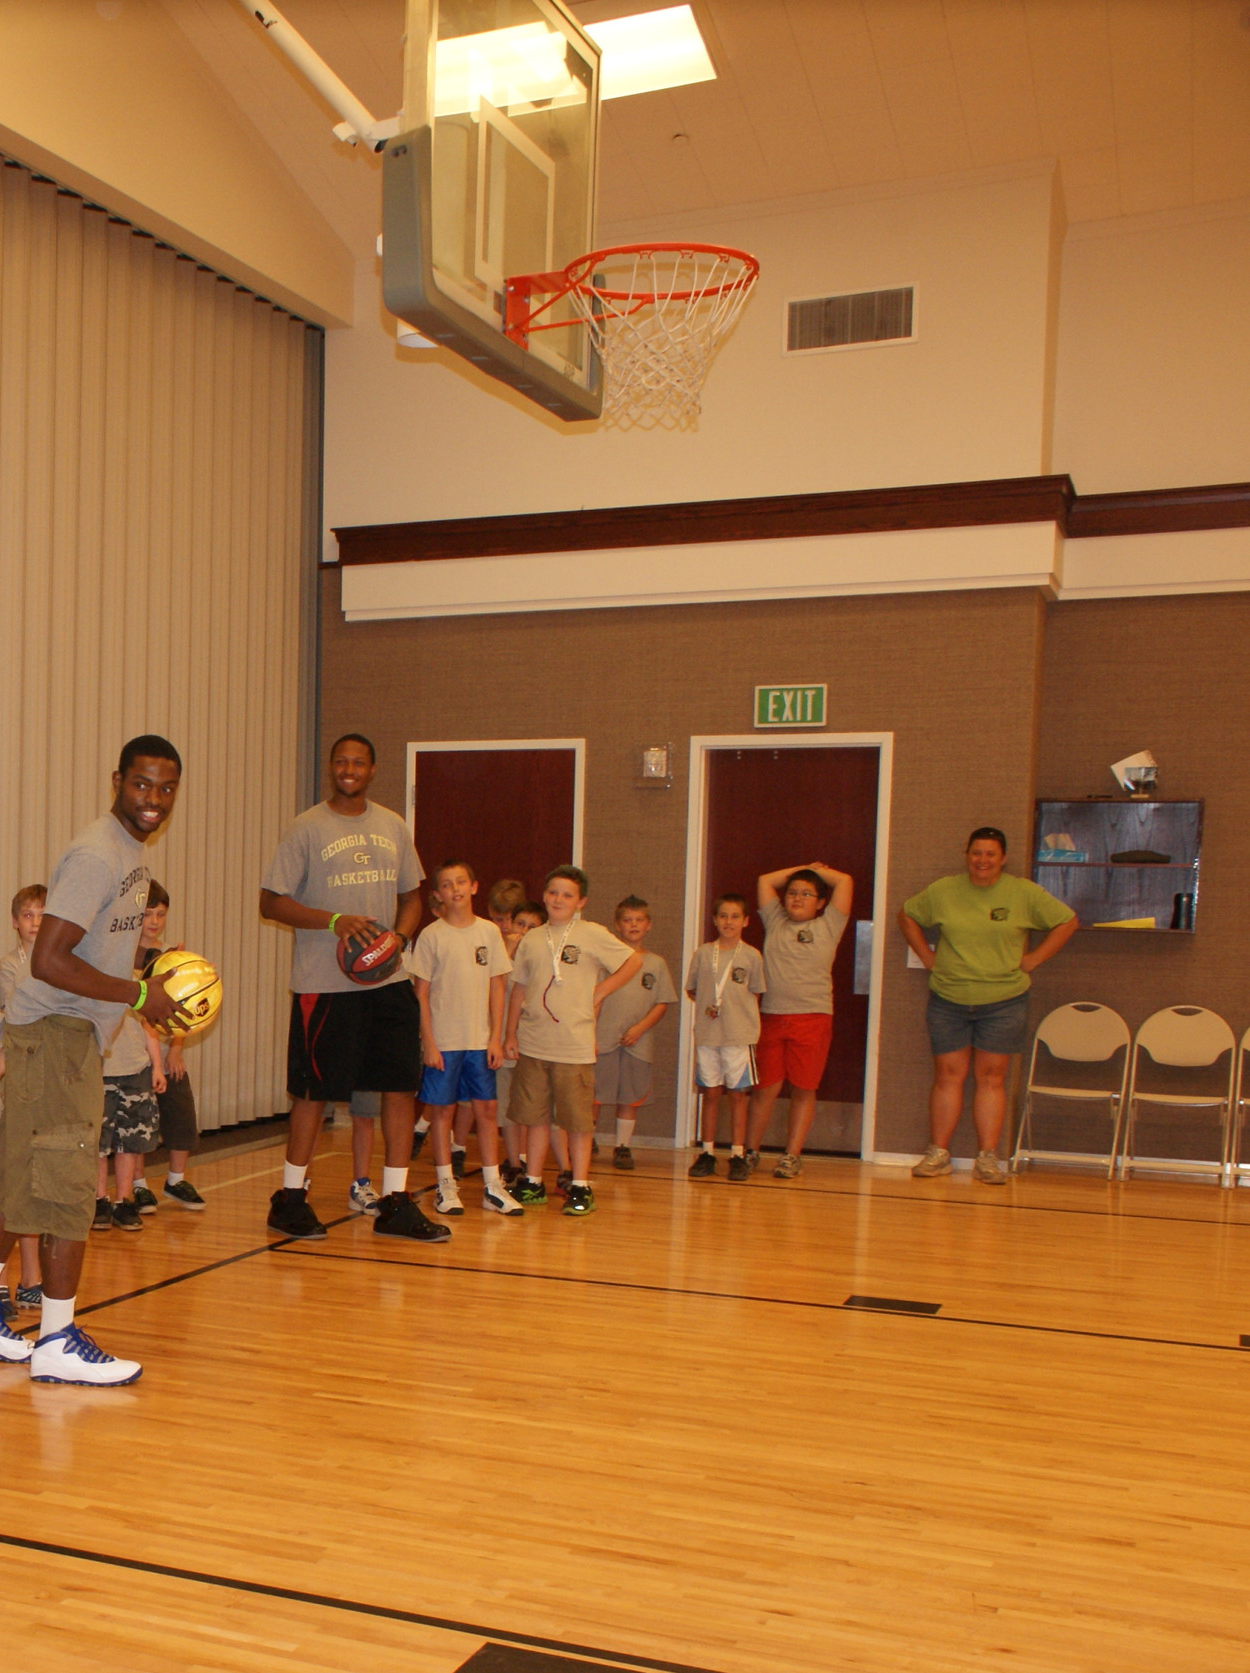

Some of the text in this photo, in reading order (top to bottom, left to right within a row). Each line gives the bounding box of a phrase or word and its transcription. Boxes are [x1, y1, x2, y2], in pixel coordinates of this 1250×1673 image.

[768, 690, 816, 722] EXIT
[321, 834, 397, 862] GEORGIA TECH
[353, 852, 371, 865] GT
[327, 868, 398, 888] BASKETBALL
[195, 1001, 210, 1016] ups
